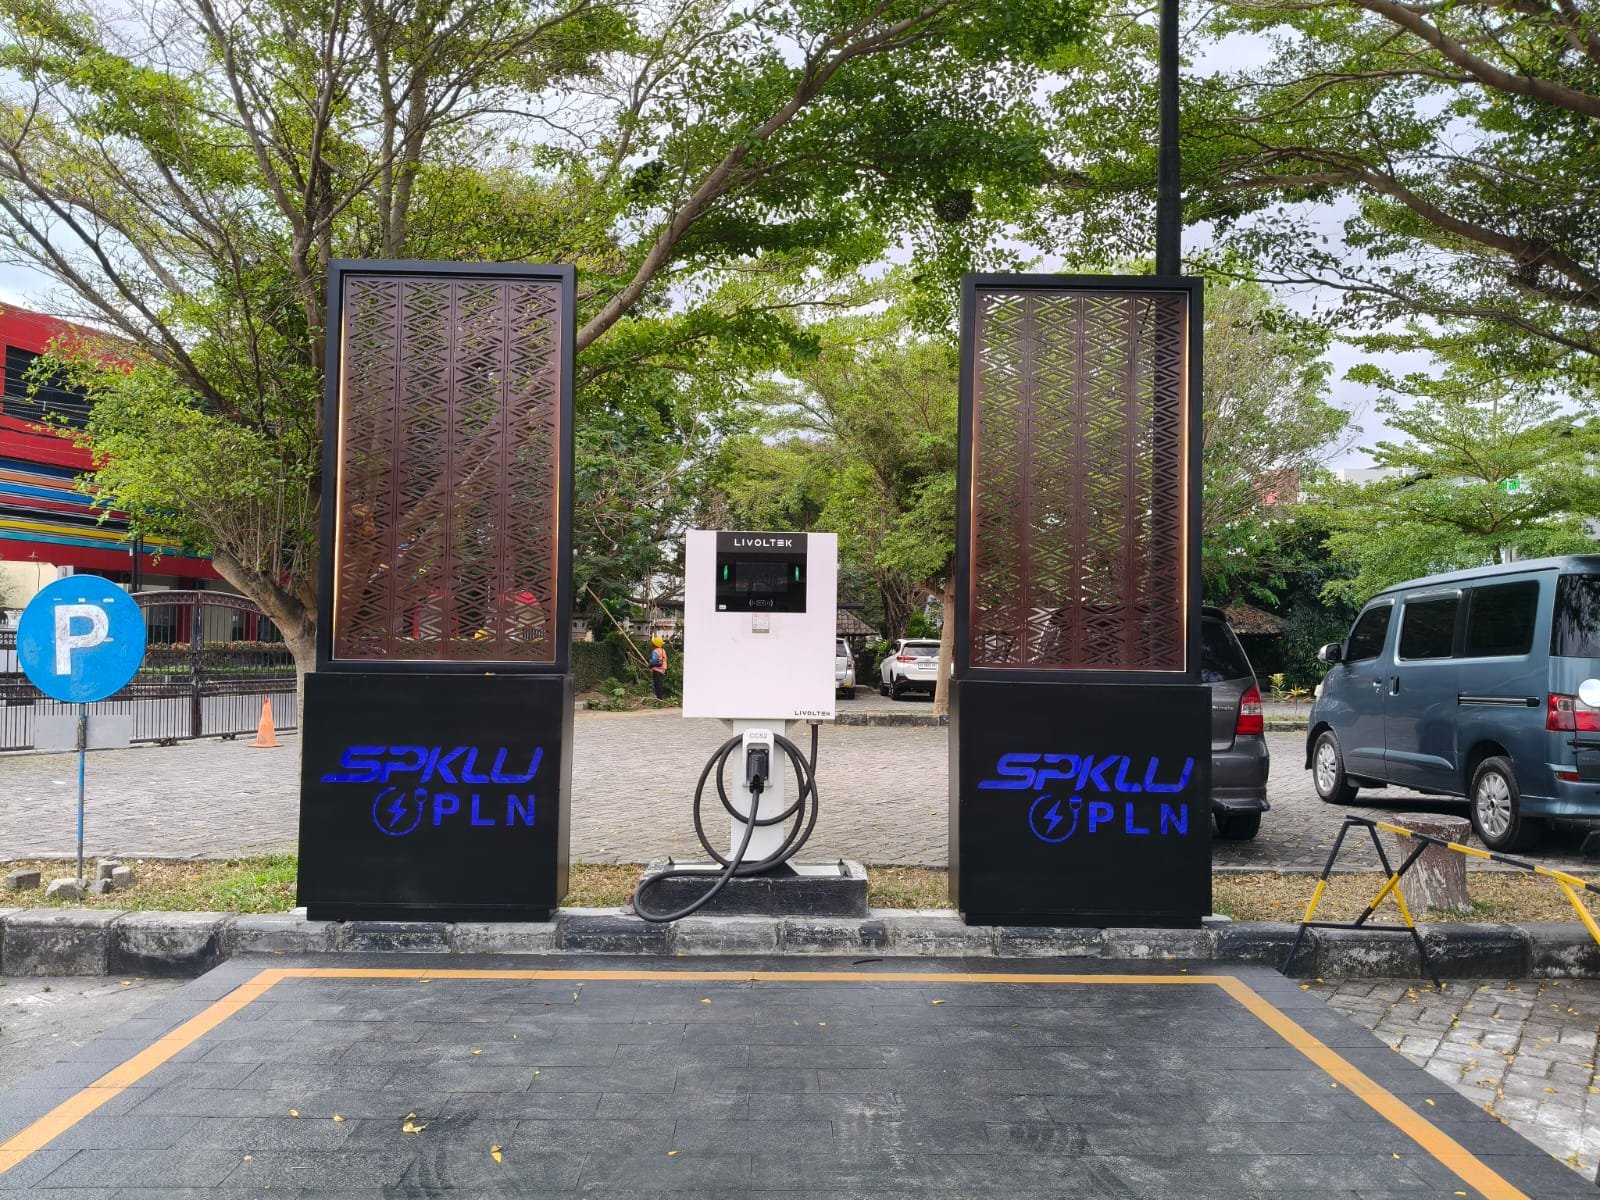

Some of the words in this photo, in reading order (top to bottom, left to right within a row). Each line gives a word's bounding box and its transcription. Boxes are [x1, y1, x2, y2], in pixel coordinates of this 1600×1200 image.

[734, 538, 793, 548] LIVOLTEK
[54, 604, 109, 676] P
[320, 745, 544, 784] SPKLU
[977, 753, 1195, 793] SPKLU
[433, 793, 536, 826] PLN
[1088, 801, 1188, 836] PLN
